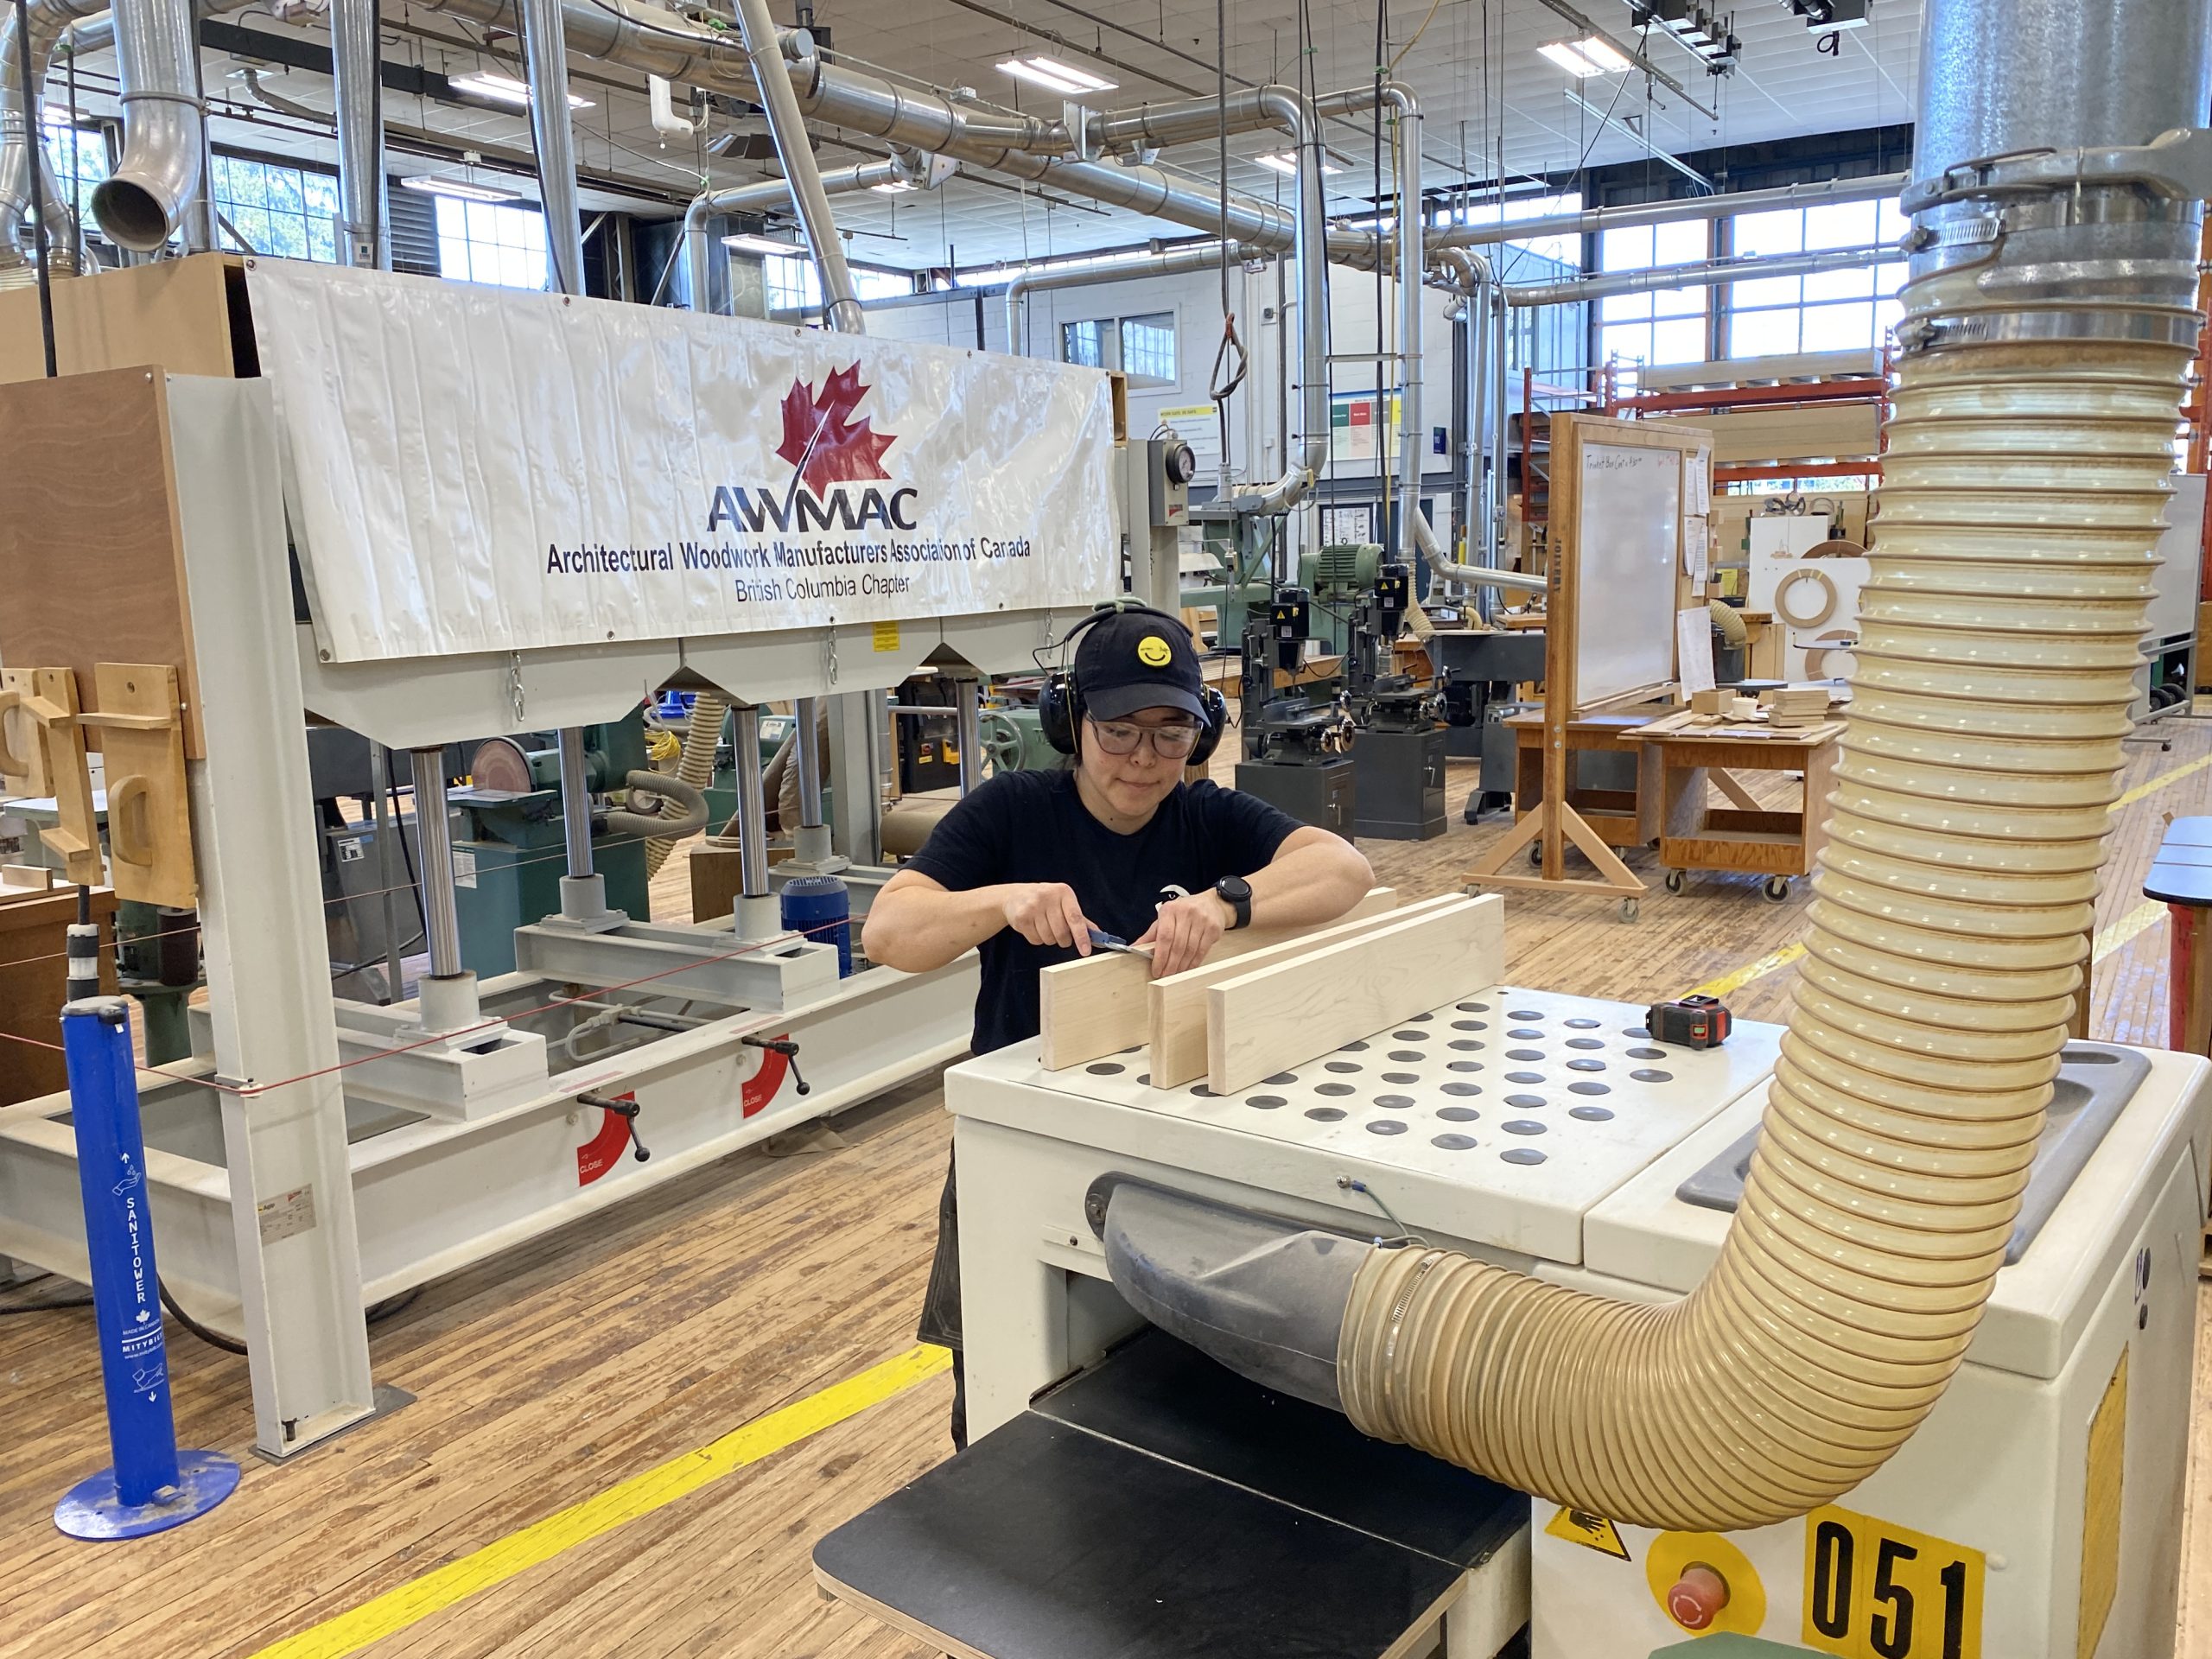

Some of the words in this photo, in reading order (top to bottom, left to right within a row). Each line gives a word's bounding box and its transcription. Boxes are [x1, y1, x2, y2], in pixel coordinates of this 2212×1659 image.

[707, 486, 918, 532] AWMAC
[547, 543, 674, 574] Architectural
[679, 542, 771, 570] Woodwork
[773, 540, 888, 567] Manufacturers
[890, 538, 962, 563] Association
[963, 537, 976, 560] of
[981, 535, 1031, 558] Canada
[735, 577, 782, 603] British
[785, 574, 856, 600] Columbia
[861, 573, 910, 599] Chapter
[743, 1093, 763, 1108] CLOSE
[579, 1158, 604, 1174] CLOSE
[126, 1197, 146, 1304] SANITOWER
[1812, 1521, 1966, 1659] 051
